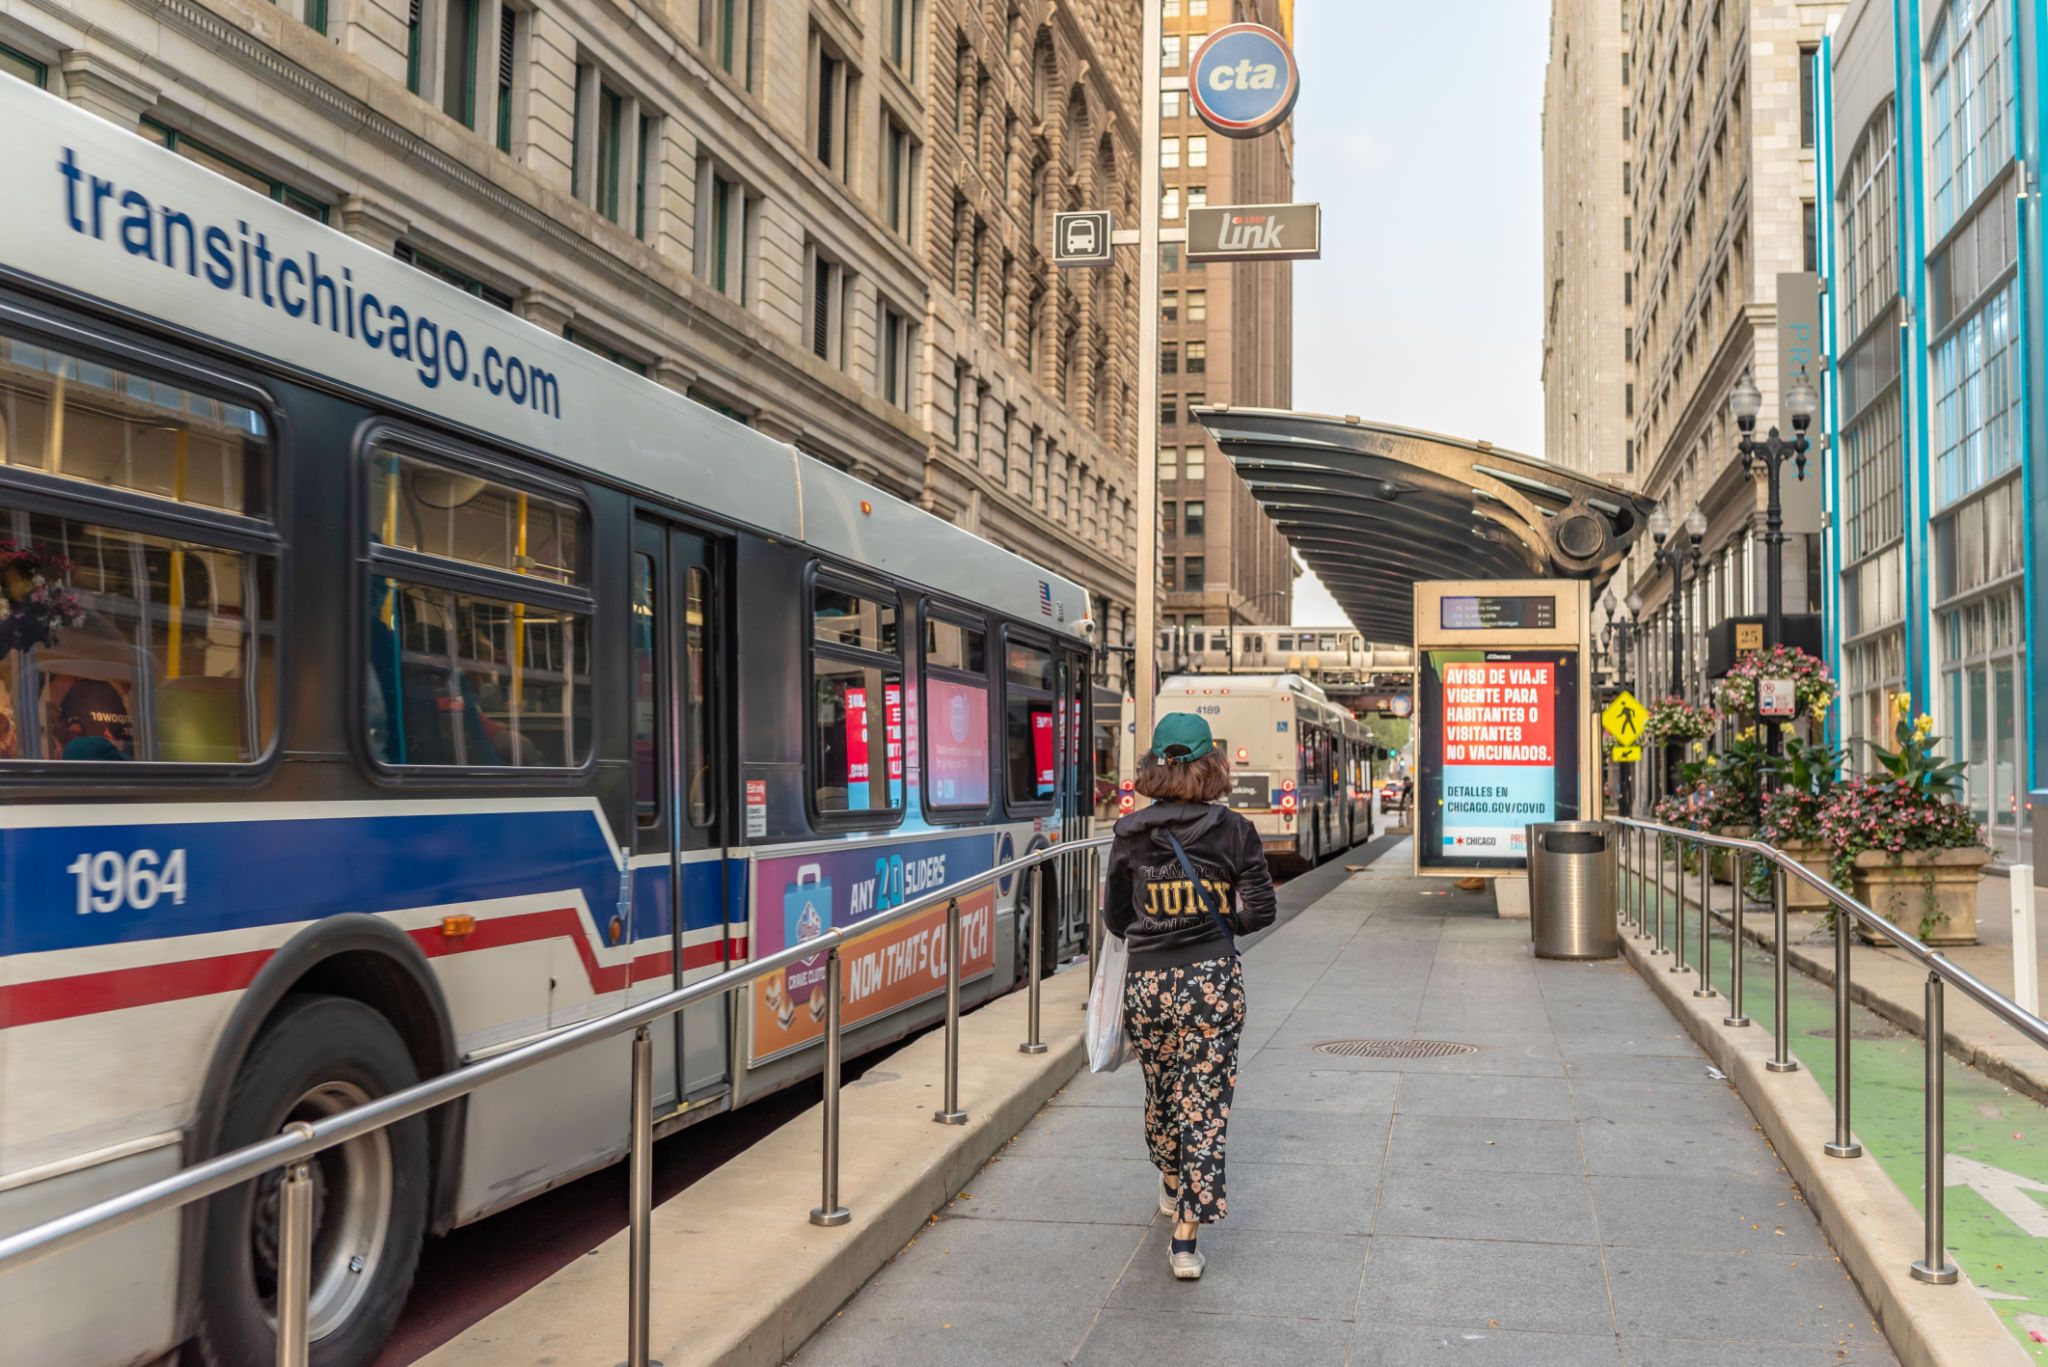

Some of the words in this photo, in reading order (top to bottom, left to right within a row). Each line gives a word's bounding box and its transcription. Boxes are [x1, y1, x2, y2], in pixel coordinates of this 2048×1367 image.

[1209, 59, 1277, 92] cta
[1217, 212, 1286, 250] Link
[57, 146, 561, 419] transitchicago.com
[1741, 630, 1758, 643] 25
[1447, 668, 1485, 685] AVISO
[1489, 668, 1506, 685] DE
[1509, 668, 1548, 685] VIAJE
[1447, 687, 1500, 704] VIGENTE
[1504, 688, 1538, 704] PARA
[1196, 705, 1221, 715] 4189
[1447, 707, 1525, 723] HABITANTES
[1529, 707, 1538, 723] O
[1447, 725, 1522, 742] VISITANTES
[1447, 745, 1465, 760] NO
[1469, 745, 1552, 761] VACUNADOS.
[1447, 786, 1493, 797] DETALLES
[1496, 787, 1508, 797] EN
[1447, 801, 1546, 814] CHICAGO.GOV/COVID
[1465, 837, 1496, 846] CHICAGO
[66, 849, 187, 915] 1964
[850, 878, 876, 916] ANY
[875, 853, 904, 910] 20
[905, 854, 946, 896] SLIDERS
[1144, 880, 1231, 915] JUICY
[850, 948, 886, 1003] NOW
[930, 906, 988, 979] CLTCH
